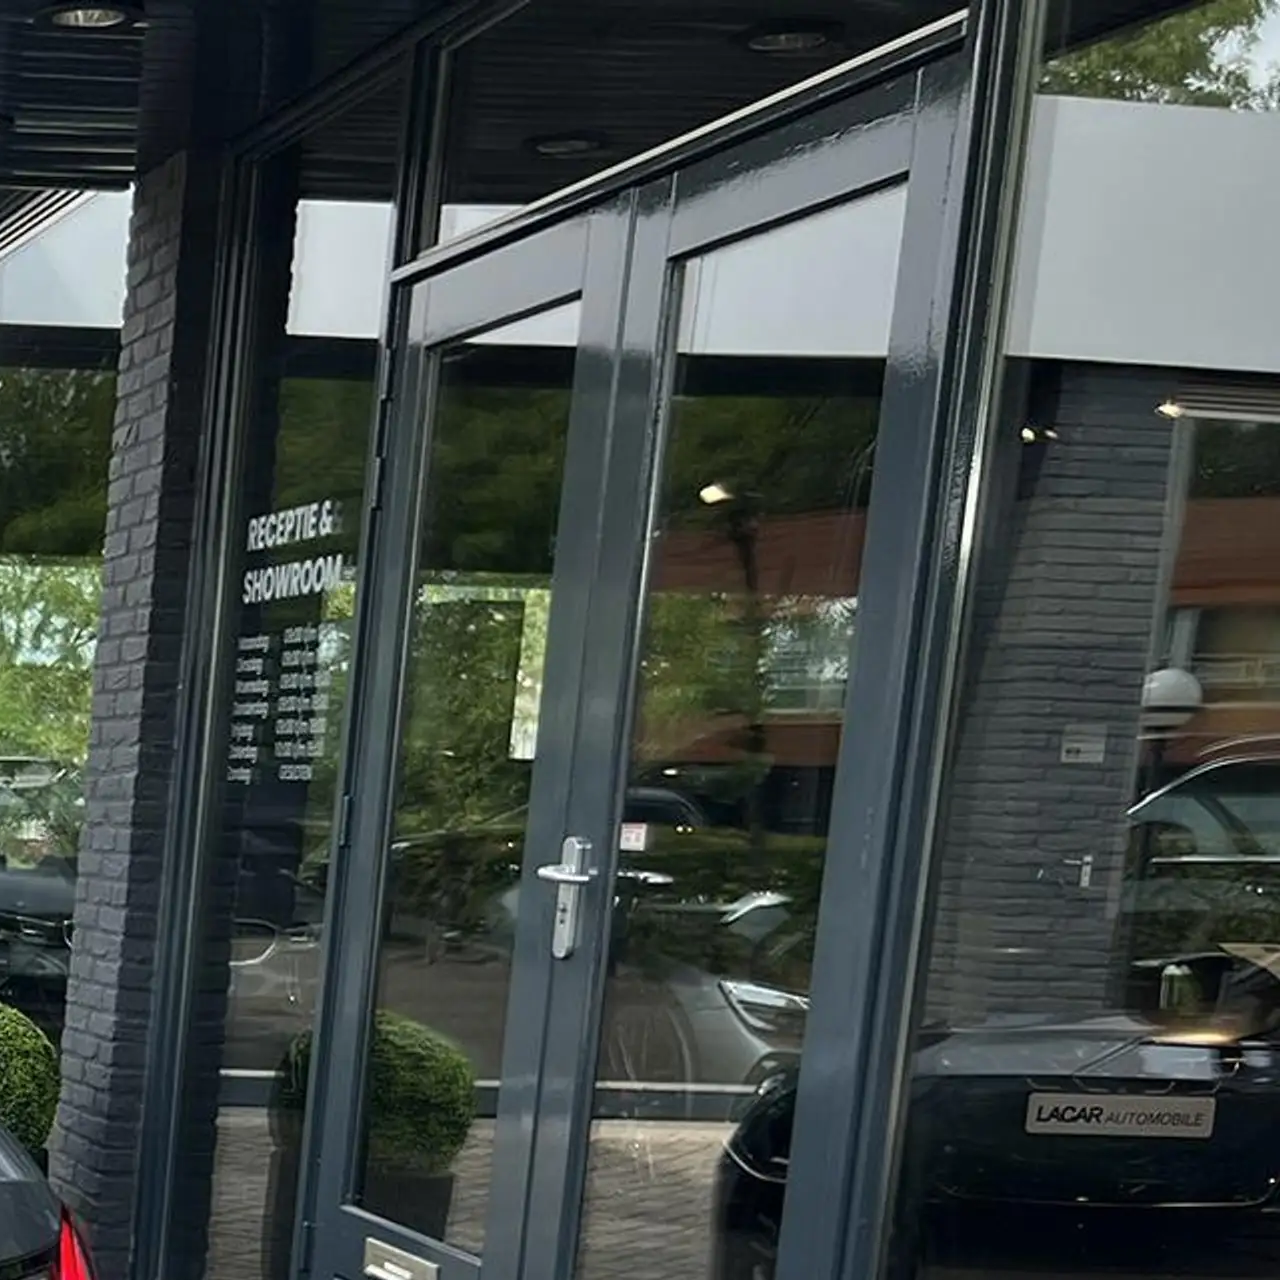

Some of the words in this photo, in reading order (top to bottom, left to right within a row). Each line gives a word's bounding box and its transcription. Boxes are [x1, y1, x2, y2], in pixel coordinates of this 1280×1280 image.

[247, 502, 318, 551] RECEPTIE
[319, 500, 333, 536] &
[242, 553, 343, 605] SHOWROOM
[1036, 1107, 1104, 1123] LACAR
[1106, 1111, 1204, 1127] AUTOMOBILE
